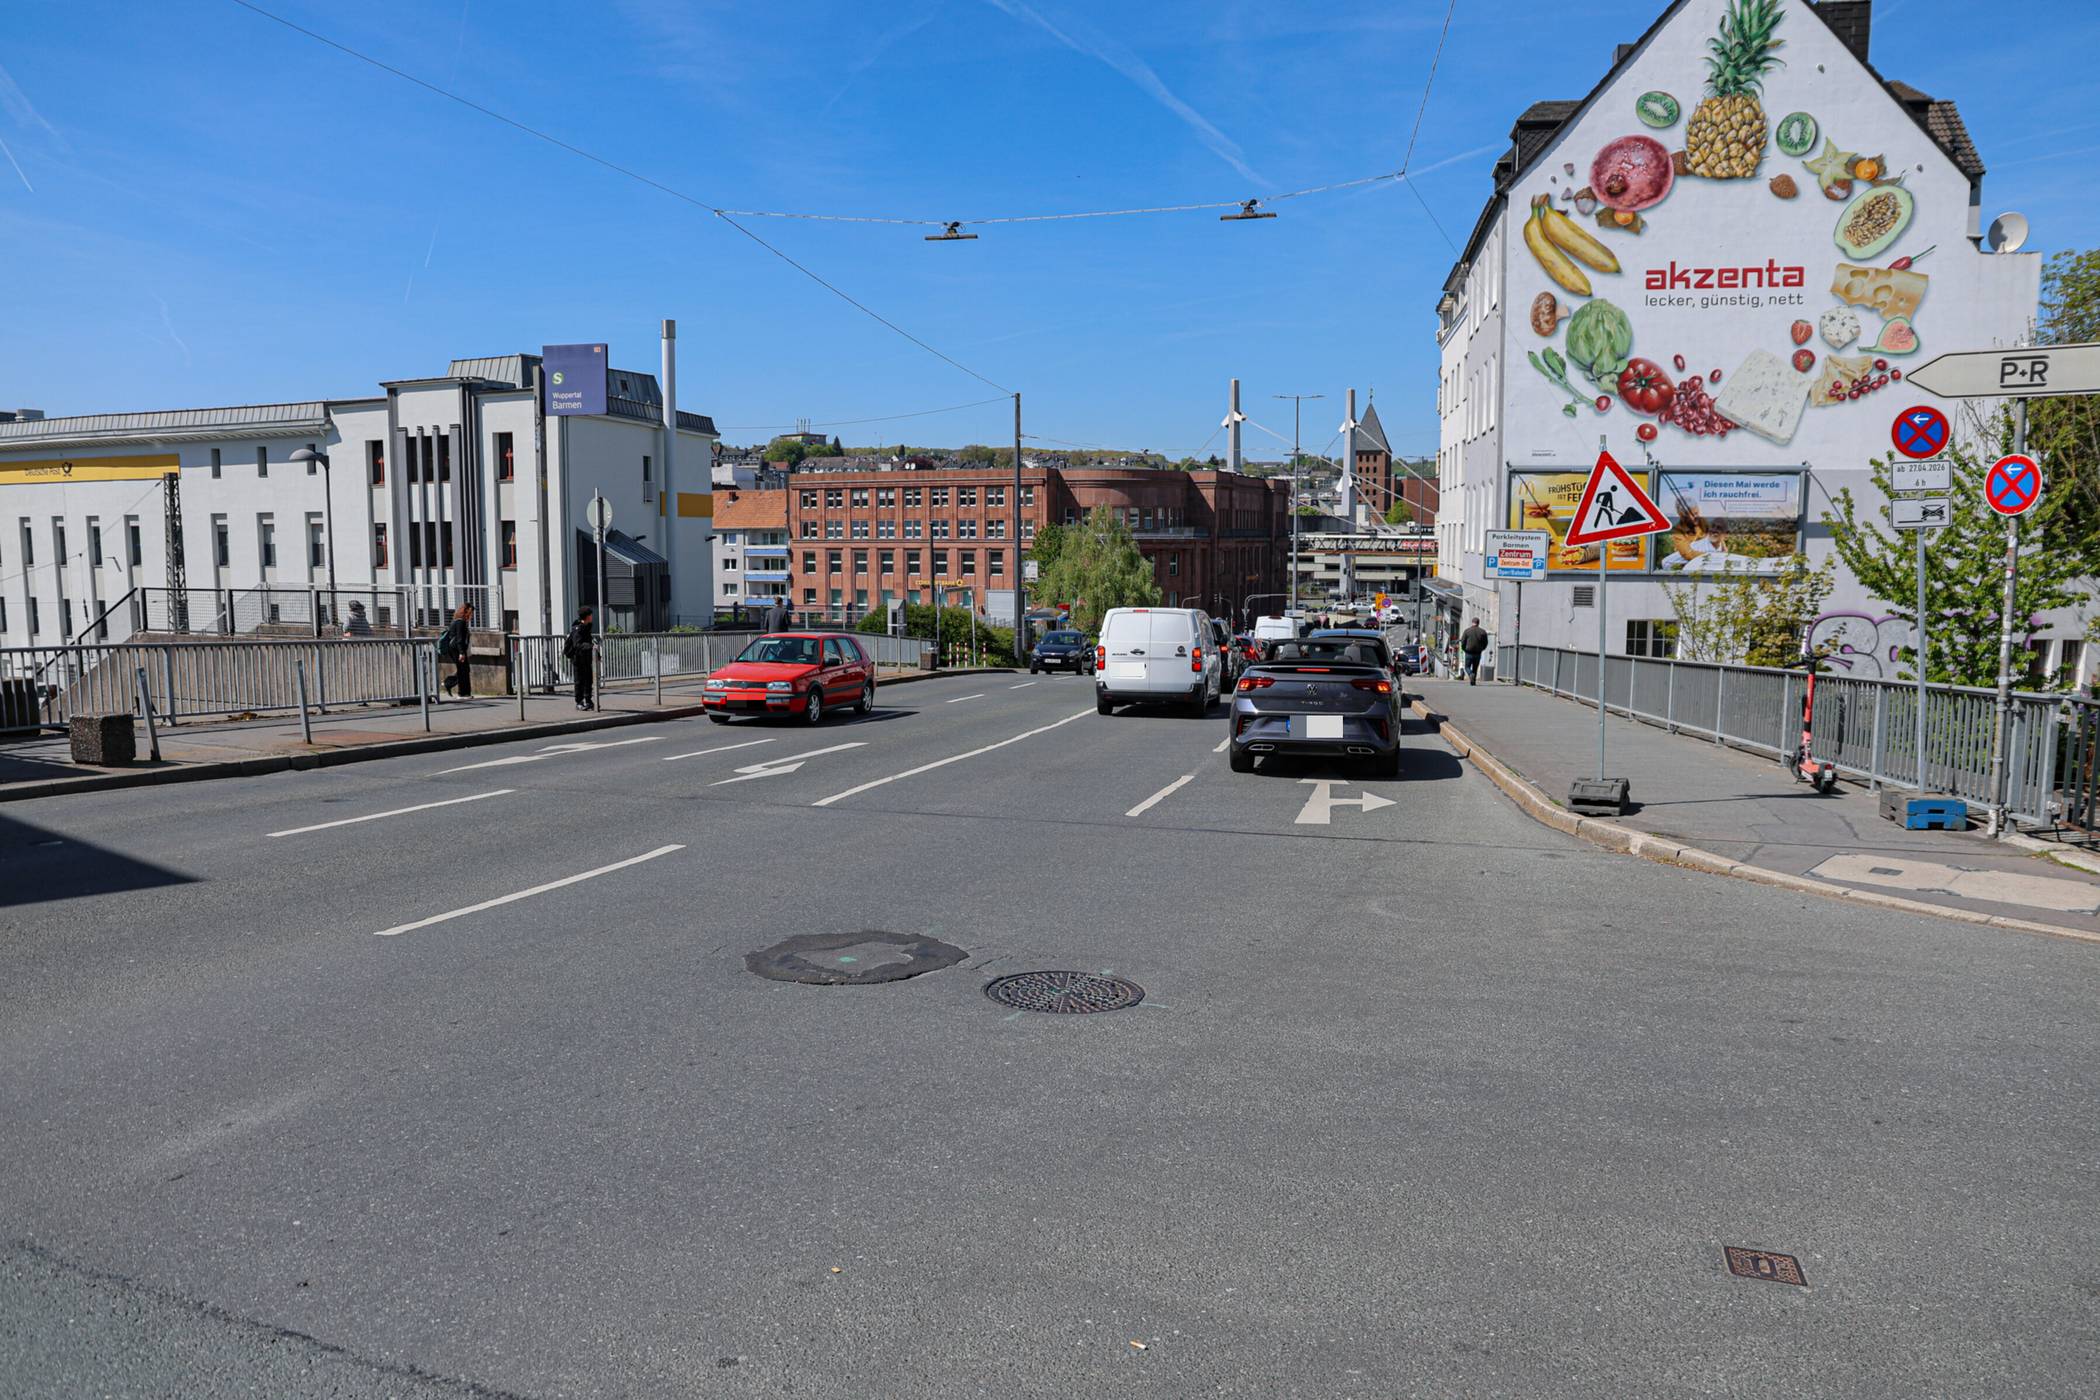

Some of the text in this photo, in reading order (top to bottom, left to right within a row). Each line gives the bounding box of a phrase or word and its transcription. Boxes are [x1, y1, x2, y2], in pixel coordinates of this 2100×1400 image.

[1645, 258, 1804, 290] akzenta
[1645, 293, 1804, 309] lecker, günstig, nett
[552, 392, 582, 400] Wuppertal
[552, 401, 582, 410] Barmen
[1704, 480, 1780, 489] Diesen Mai werde
[1719, 490, 1762, 498] rauchfrei.
[1492, 533, 1542, 541] Parkleitsystem
[1500, 549, 1532, 558] Zentrum
